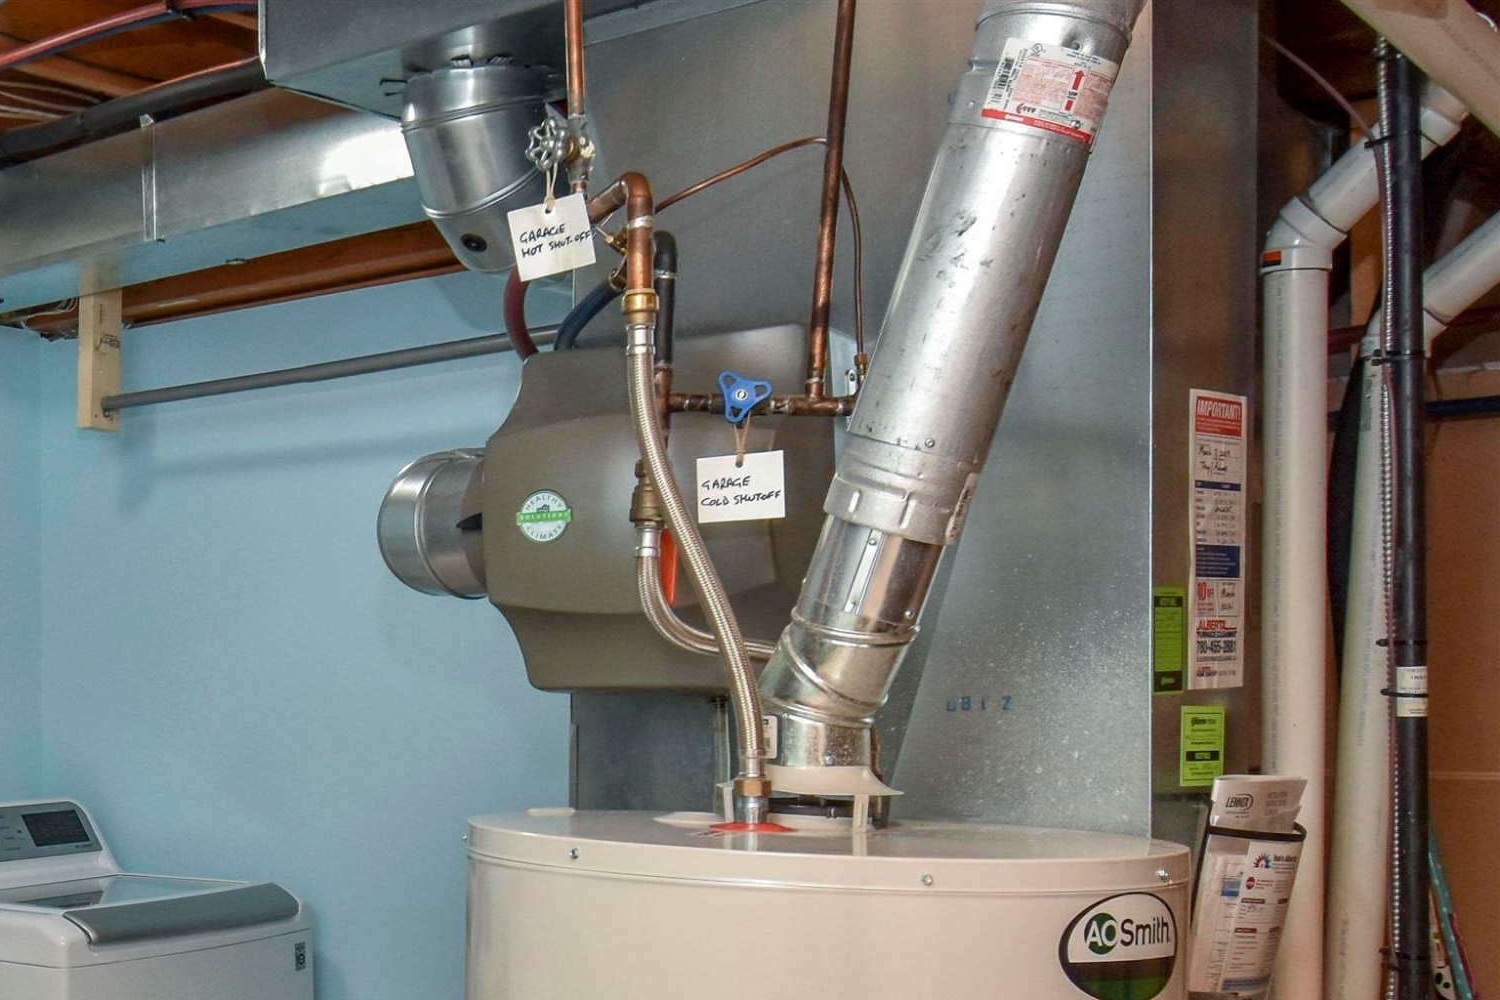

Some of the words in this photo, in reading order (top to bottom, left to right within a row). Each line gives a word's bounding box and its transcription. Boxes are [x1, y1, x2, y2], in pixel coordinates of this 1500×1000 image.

[520, 223, 566, 244] GARAGE
[521, 243, 544, 258] HOT
[1197, 399, 1241, 420] IMPORTANT!
[701, 476, 751, 490] GARAGE
[700, 496, 729, 506] COLD
[734, 490, 781, 505] SHUTOFF
[1120, 916, 1169, 947] Smith
